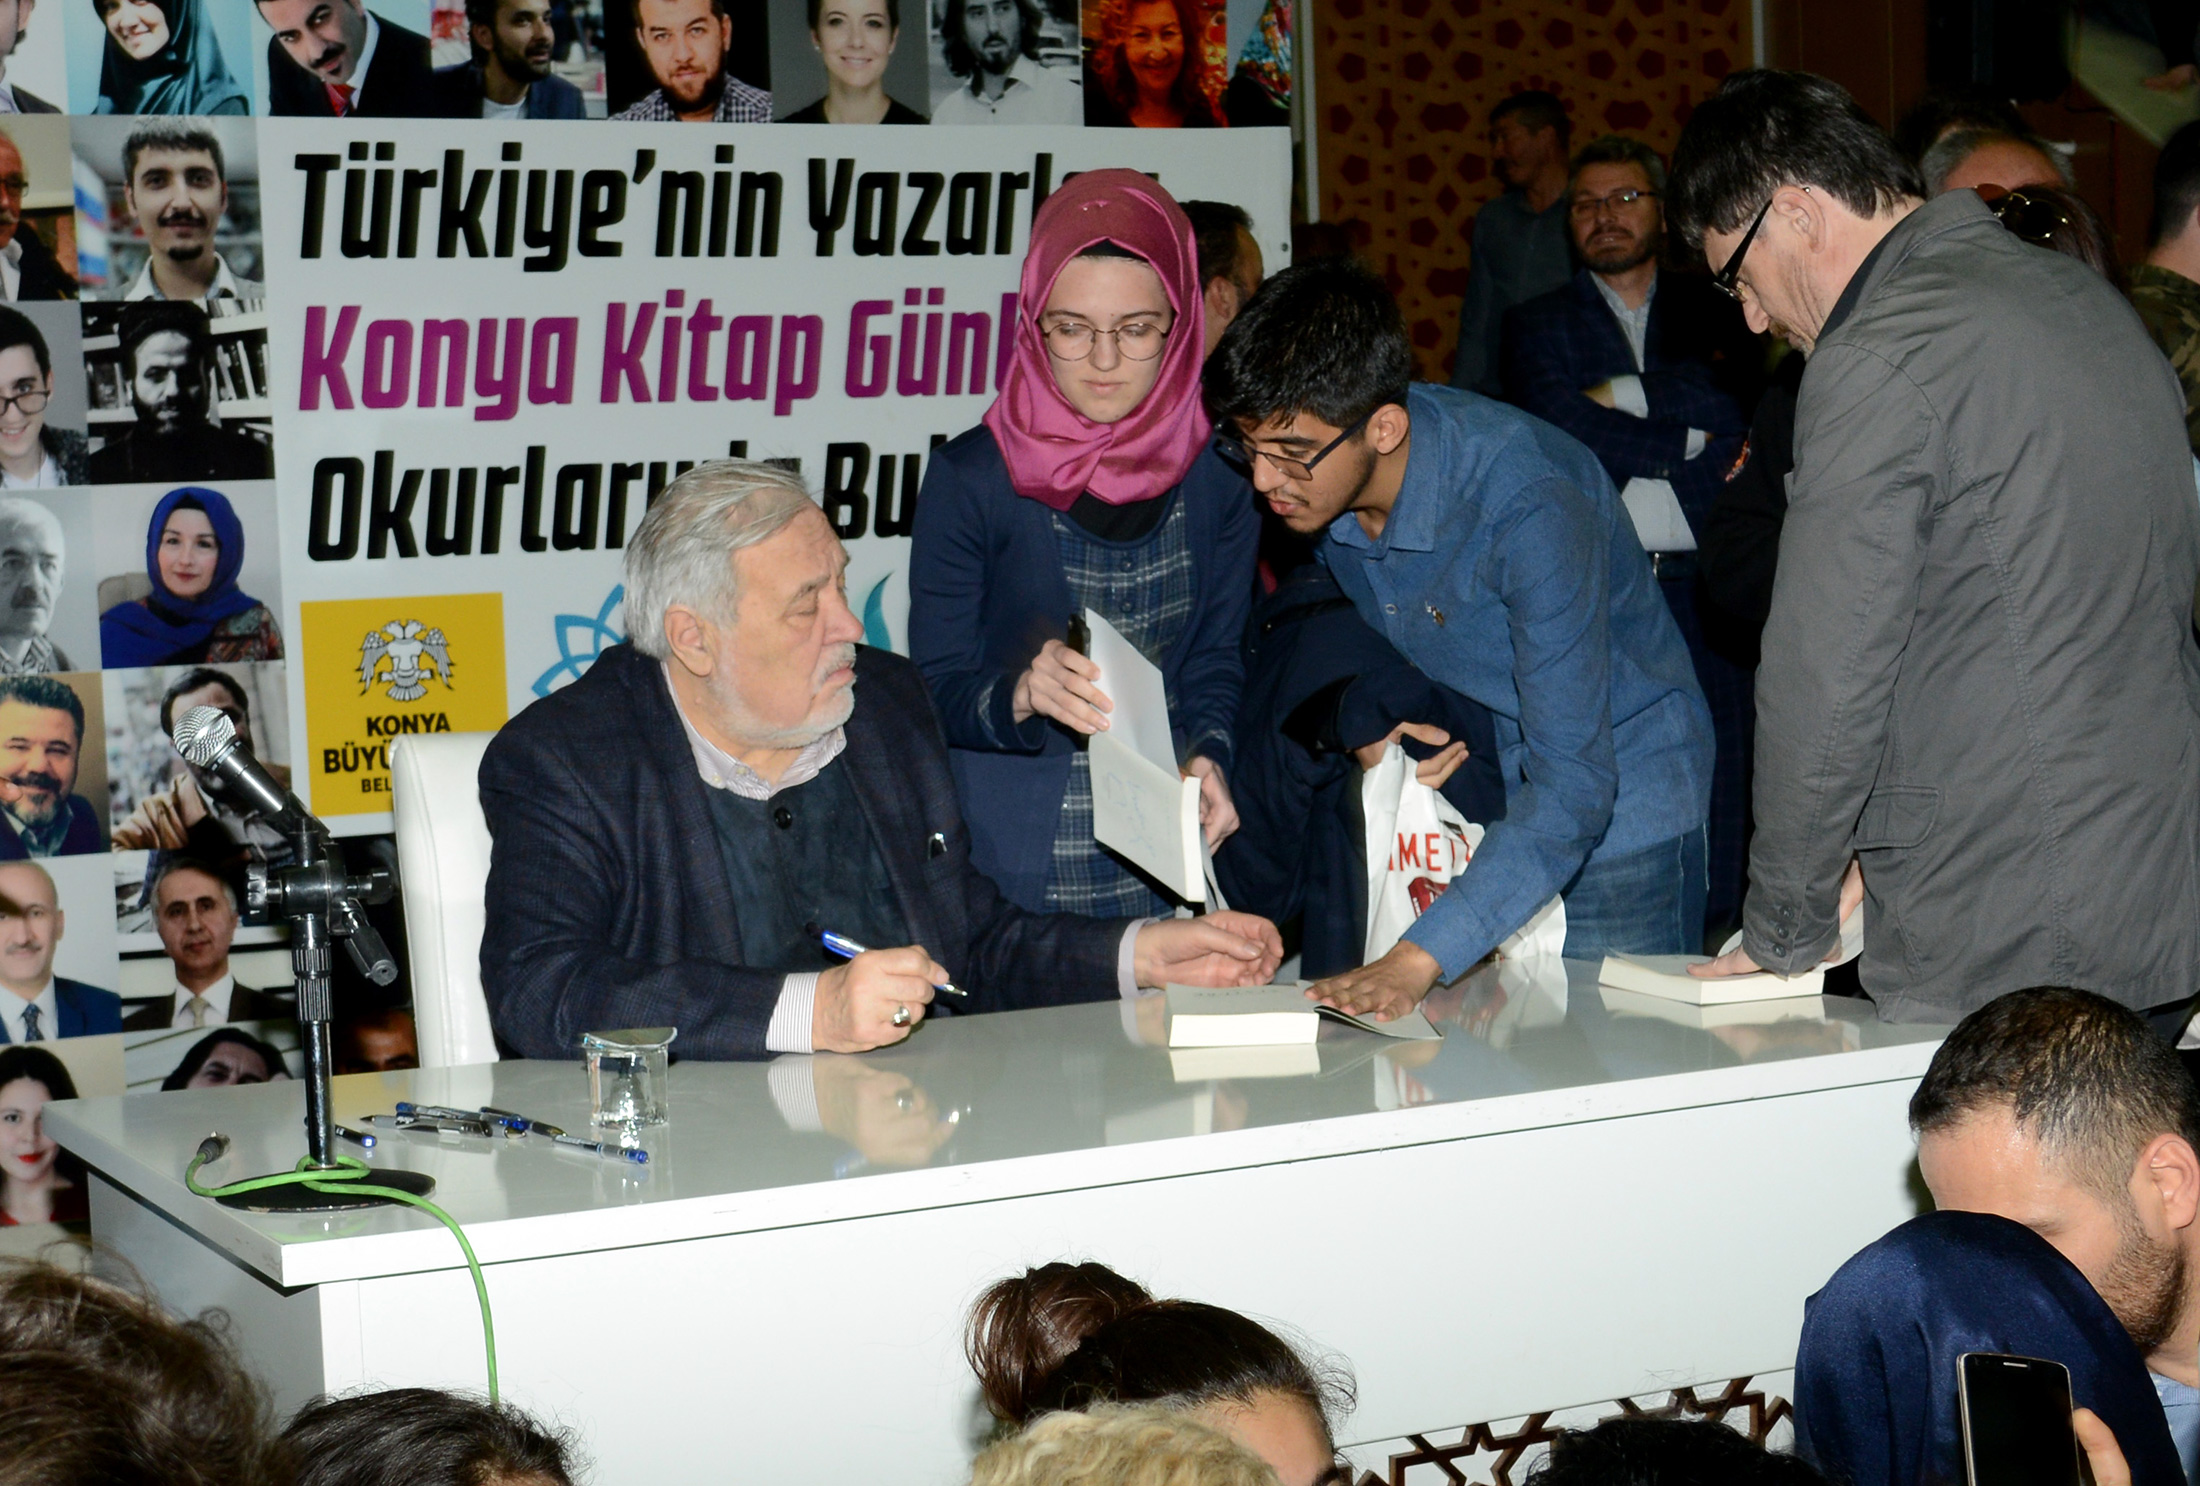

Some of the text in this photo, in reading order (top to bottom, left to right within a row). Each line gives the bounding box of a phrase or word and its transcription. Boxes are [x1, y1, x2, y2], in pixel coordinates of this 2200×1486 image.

[294, 141, 1158, 272] Türkiye'nin Yazarl
[298, 287, 1018, 421] Konya Kitap Günl
[366, 712, 451, 737] KONYA
[323, 738, 391, 774] BÜYÜ
[361, 777, 392, 793] BEL
